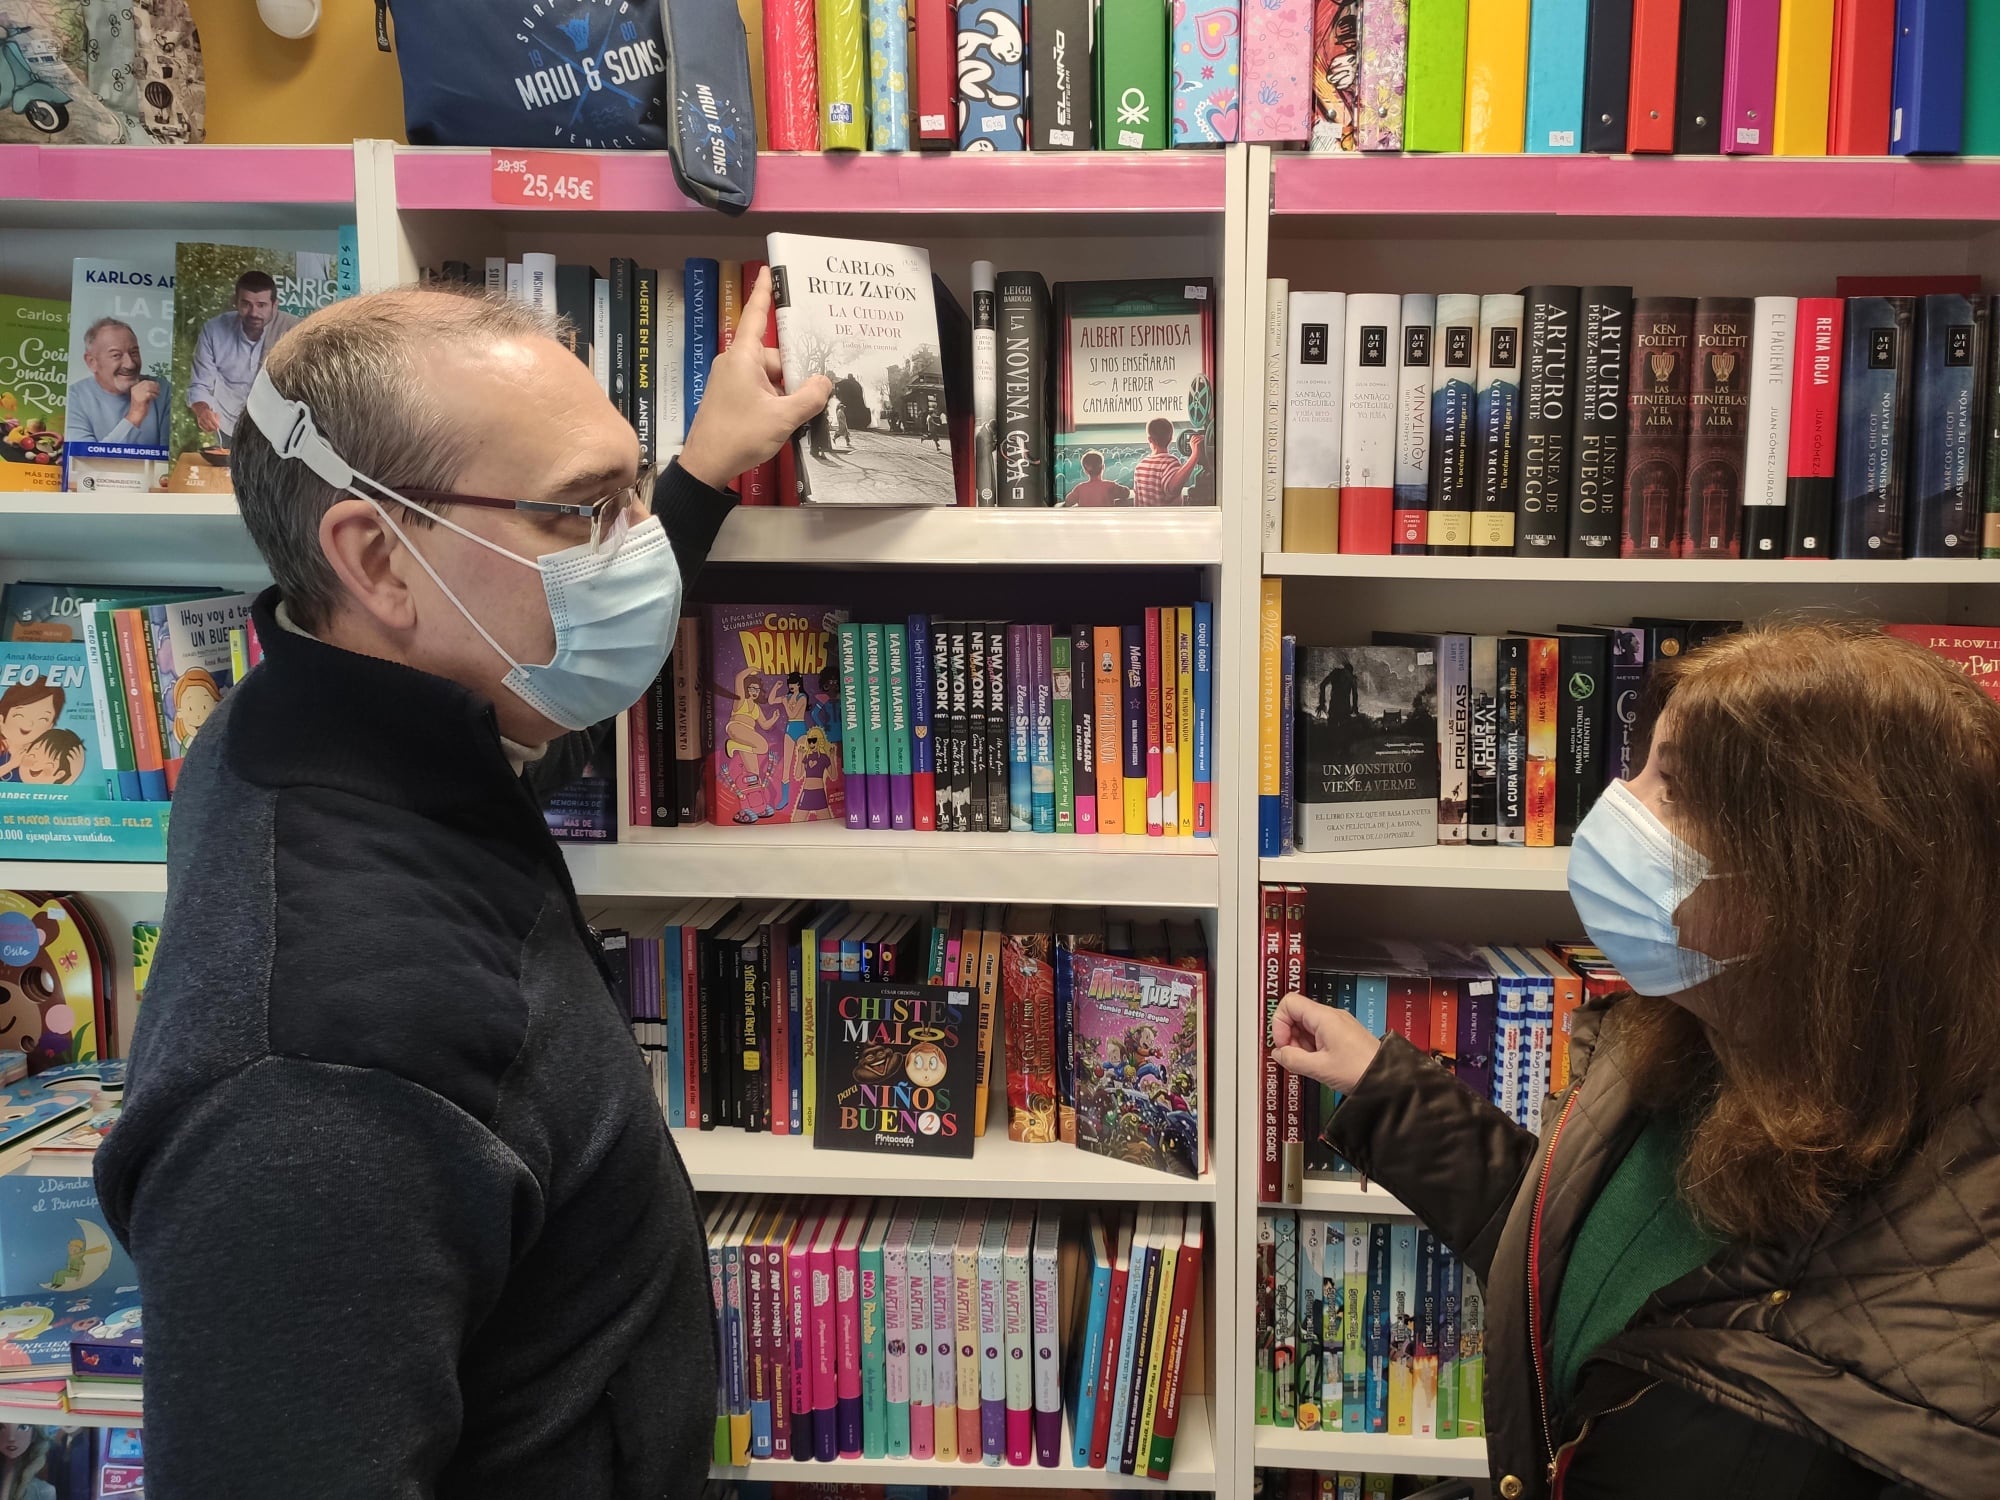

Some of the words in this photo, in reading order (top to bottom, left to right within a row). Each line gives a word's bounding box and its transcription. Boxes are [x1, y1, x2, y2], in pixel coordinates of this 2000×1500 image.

[1053, 29, 1065, 90] NIÑO
[515, 63, 580, 111] MAUI
[582, 57, 602, 91] &
[604, 39, 666, 85] SONS
[695, 84, 718, 120] MAUI
[1057, 91, 1065, 125] EL
[709, 123, 722, 134] &
[710, 138, 727, 176] SONS
[523, 174, 593, 200] 25,45€
[86, 270, 153, 287] KARLOS
[694, 269, 703, 286] LA
[826, 256, 895, 278] CARLOS
[640, 280, 648, 326] MUERTE
[808, 276, 853, 298] RUIZ
[860, 281, 916, 302] ZAFÓN
[1004, 286, 1031, 296] LEIGH
[1004, 294, 1032, 304] BARDUGO
[17, 308, 62, 323] Carlos
[115, 296, 152, 319] LA
[694, 289, 703, 336] NOVELA
[829, 305, 849, 319] LA
[853, 306, 904, 323] CIUDAD
[1771, 313, 1785, 326] EL
[640, 329, 648, 344] EN
[836, 323, 855, 335] DE
[859, 323, 902, 339] VAPOR
[1009, 315, 1025, 334] LA
[1080, 326, 1124, 349] ALBERT
[1130, 323, 1191, 346] ESPINOSA
[1653, 324, 1676, 334] KEN
[1816, 317, 1832, 353] REINA
[640, 346, 648, 360] EL
[693, 338, 703, 367] DEL
[1638, 334, 1688, 348] FOLLETT
[1090, 358, 1099, 372] SI
[1100, 358, 1119, 372] NOS
[1121, 353, 1176, 371] ENSEÑARAN
[1529, 304, 1546, 420] PÉREZ-REVERTE
[1542, 304, 1568, 420] ARTURO
[1769, 329, 1784, 385] PACIENTE
[1813, 356, 1830, 386] ROJA
[640, 364, 648, 388] MAR
[1006, 337, 1030, 424] NOVENA
[1112, 377, 1119, 390] A
[1121, 376, 1154, 390] PERDER
[1269, 353, 1280, 396] ESPAÑA
[693, 373, 703, 406] AGUA
[1083, 394, 1143, 413] GANARÍAMOS
[1147, 397, 1183, 412] SIEMPRE
[1290, 399, 1336, 407] POSTEGUILLO
[1295, 391, 1331, 399] SANTIAGO
[1632, 395, 1687, 406] TINIEBLAS
[1655, 385, 1669, 394] LAS
[639, 398, 648, 442] JANETH
[1268, 400, 1279, 416] DE
[1446, 380, 1456, 441] BARNEDA
[1646, 415, 1673, 426] ALBA
[1652, 406, 1659, 414] Y
[1659, 406, 1668, 414] EL
[1769, 406, 1779, 431] JUAN
[1882, 392, 1891, 429] PLATÓN
[1412, 384, 1426, 470] AQUITANIA
[1869, 413, 1878, 449] CHICOT
[1882, 433, 1889, 445] DE
[123, 448, 159, 456] MEJORES
[1006, 430, 1030, 483] CASA
[1267, 419, 1278, 474] HISTORIA
[1546, 434, 1562, 486] LÍNEA
[1443, 448, 1453, 501] SANDRA
[1523, 434, 1545, 513] FUEGO
[1765, 432, 1778, 507] GÓMEZ-JURADO
[1868, 453, 1876, 492] MARCOS
[1879, 449, 1888, 500] ASESINATO
[1266, 479, 1277, 502] UNA
[1545, 493, 1558, 513] DE
[1879, 504, 1885, 513] EL
[180, 610, 204, 627] ¡Hoy
[207, 611, 225, 623] voy
[228, 611, 234, 619] a
[764, 612, 809, 631] Coño
[191, 633, 205, 648] UN
[739, 631, 830, 675] DRAMAS
[842, 632, 856, 674] KARINA
[935, 633, 947, 669] NEW
[952, 635, 964, 670] NEW
[6, 653, 25, 661] Anna
[56, 653, 81, 661] García
[1129, 646, 1141, 687] Mellizas
[937, 670, 948, 710] YORK
[954, 671, 965, 712] YORK
[1017, 684, 1027, 715] Elena
[1264, 658, 1273, 718] ILUSTRADA
[845, 685, 858, 731] MARINA
[679, 695, 687, 751] SOTAVENTO
[1455, 684, 1467, 770] PRUEBAS
[1486, 697, 1497, 776] MORTAL
[1016, 716, 1028, 763] Sirena
[1083, 713, 1092, 773] FUTBOLERAS
[1508, 729, 1518, 767] MORTAL
[1323, 763, 1341, 775] UN
[1344, 762, 1412, 775] MONSTRUO
[1323, 779, 1362, 793] VIENE
[1365, 779, 1372, 790] A
[1375, 778, 1416, 790] VERME
[1508, 769, 1518, 799] CURA
[1508, 802, 1518, 817] LA
[26, 832, 71, 843] ejemplares
[74, 832, 115, 843] vendidos.
[571, 829, 607, 837] LECTORES
[1268, 932, 1279, 954] THE
[1289, 932, 1302, 953] THE
[986, 952, 994, 975] #Team
[1267, 958, 1279, 997] CRAZY
[983, 978, 991, 995] Nico
[838, 996, 963, 1025] CHISTES
[1021, 999, 1033, 1029] LIBRO
[1098, 1004, 1121, 1013] Zombie
[1124, 1009, 1145, 1019] Battle
[1147, 1014, 1170, 1024] Royale
[1022, 1031, 1035, 1061] GRAN
[1038, 1042, 1050, 1075] REINO
[1506, 1051, 1515, 1069] Greg
[837, 1084, 858, 1105] para
[859, 1081, 951, 1112] NIÑOS
[1505, 1078, 1513, 1112] DIARIO
[38, 1178, 90, 1194] ¿Dónde
[863, 1271, 876, 1299] NOA
[885, 1275, 898, 1329] MARTINA
[910, 1277, 924, 1331] MARTINA
[1034, 1279, 1047, 1335] MARTINA
[794, 1328, 801, 1338] DE
